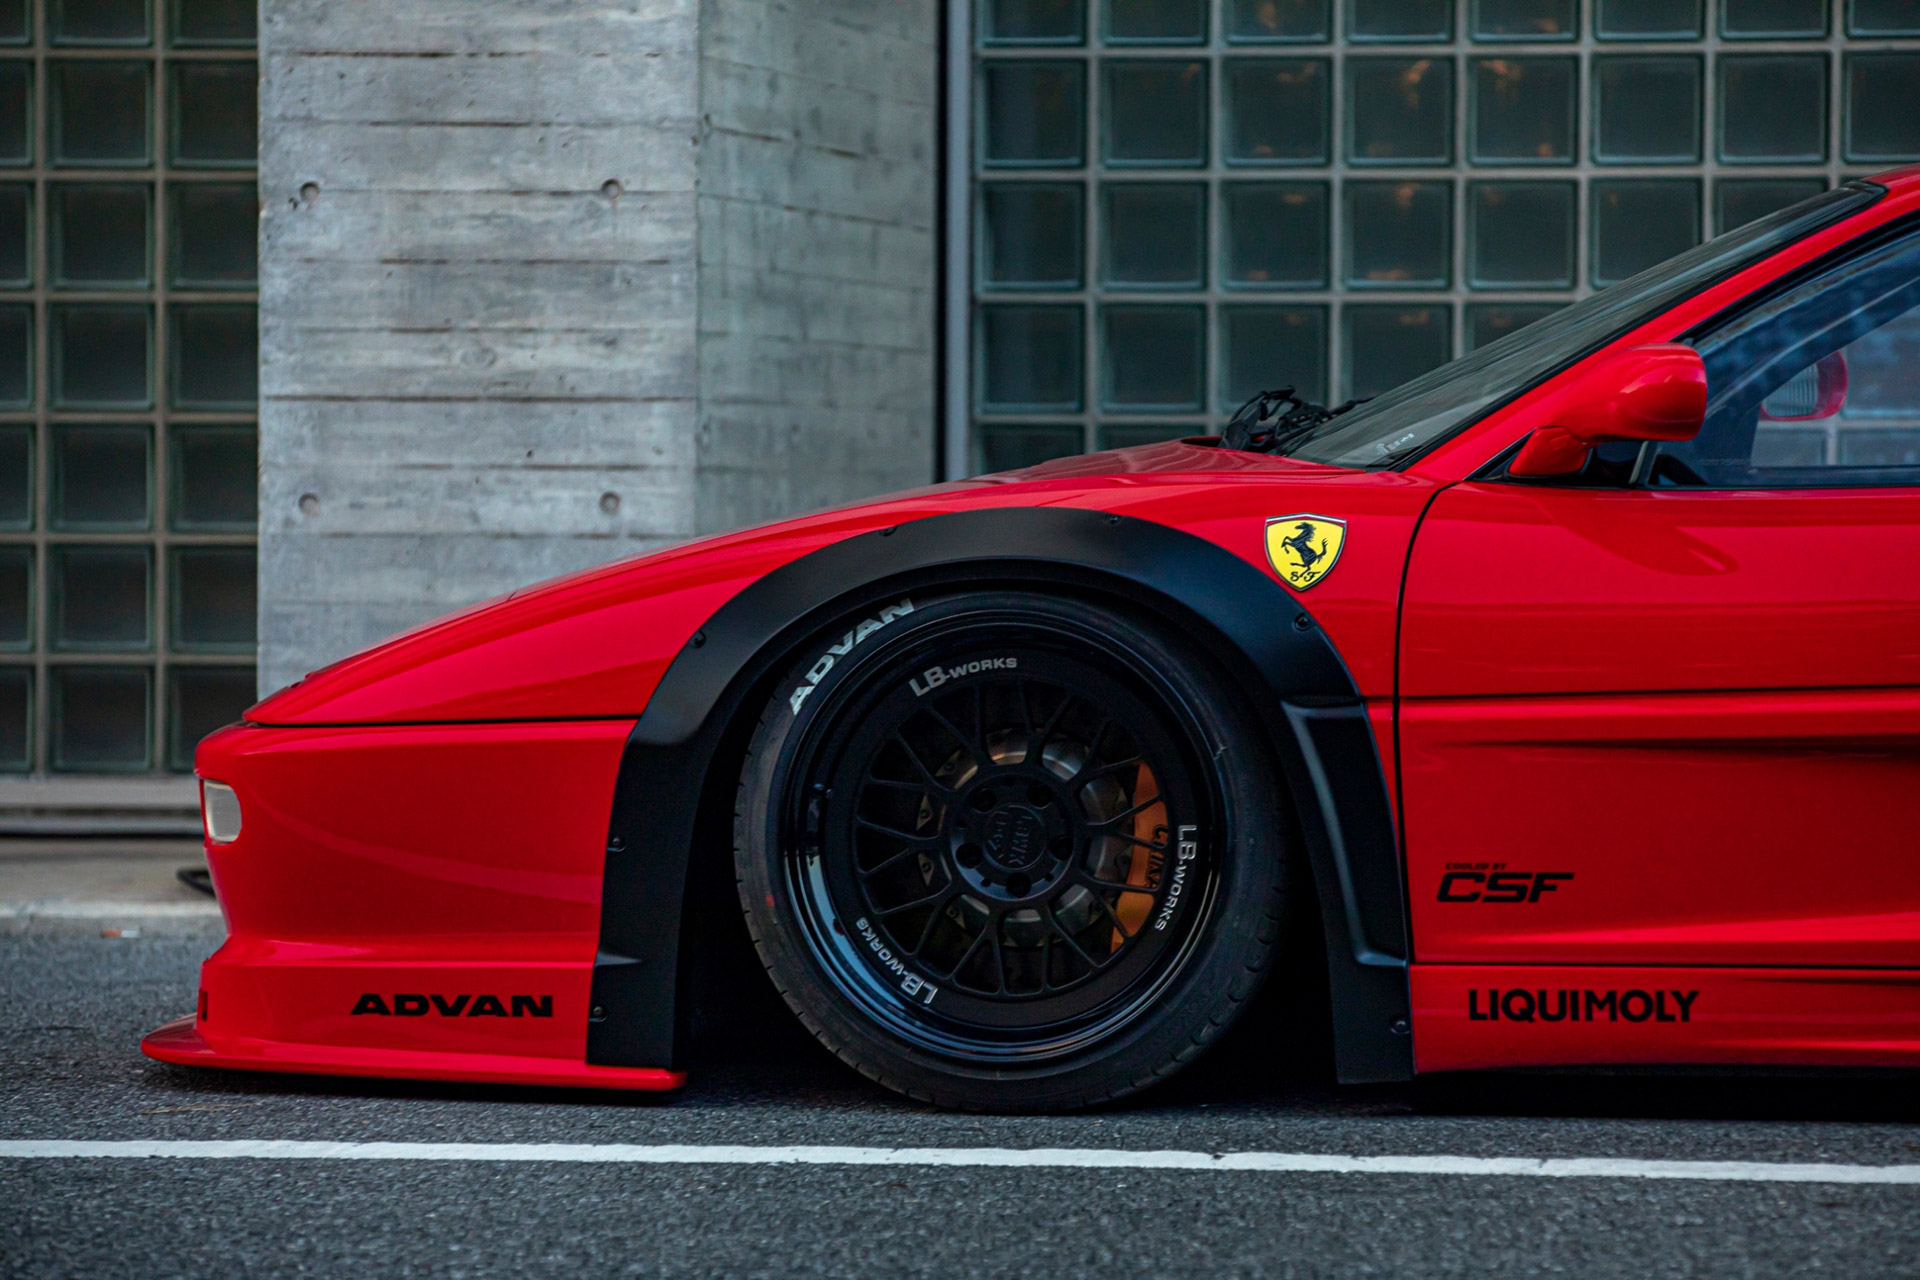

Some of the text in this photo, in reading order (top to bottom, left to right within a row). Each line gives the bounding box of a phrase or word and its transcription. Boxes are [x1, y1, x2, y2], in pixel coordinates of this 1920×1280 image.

[789, 598, 914, 715] ADVAN
[1445, 862, 1507, 870] COOLED BY
[1437, 872, 1575, 903] CSF
[349, 993, 553, 1018] ADVAN
